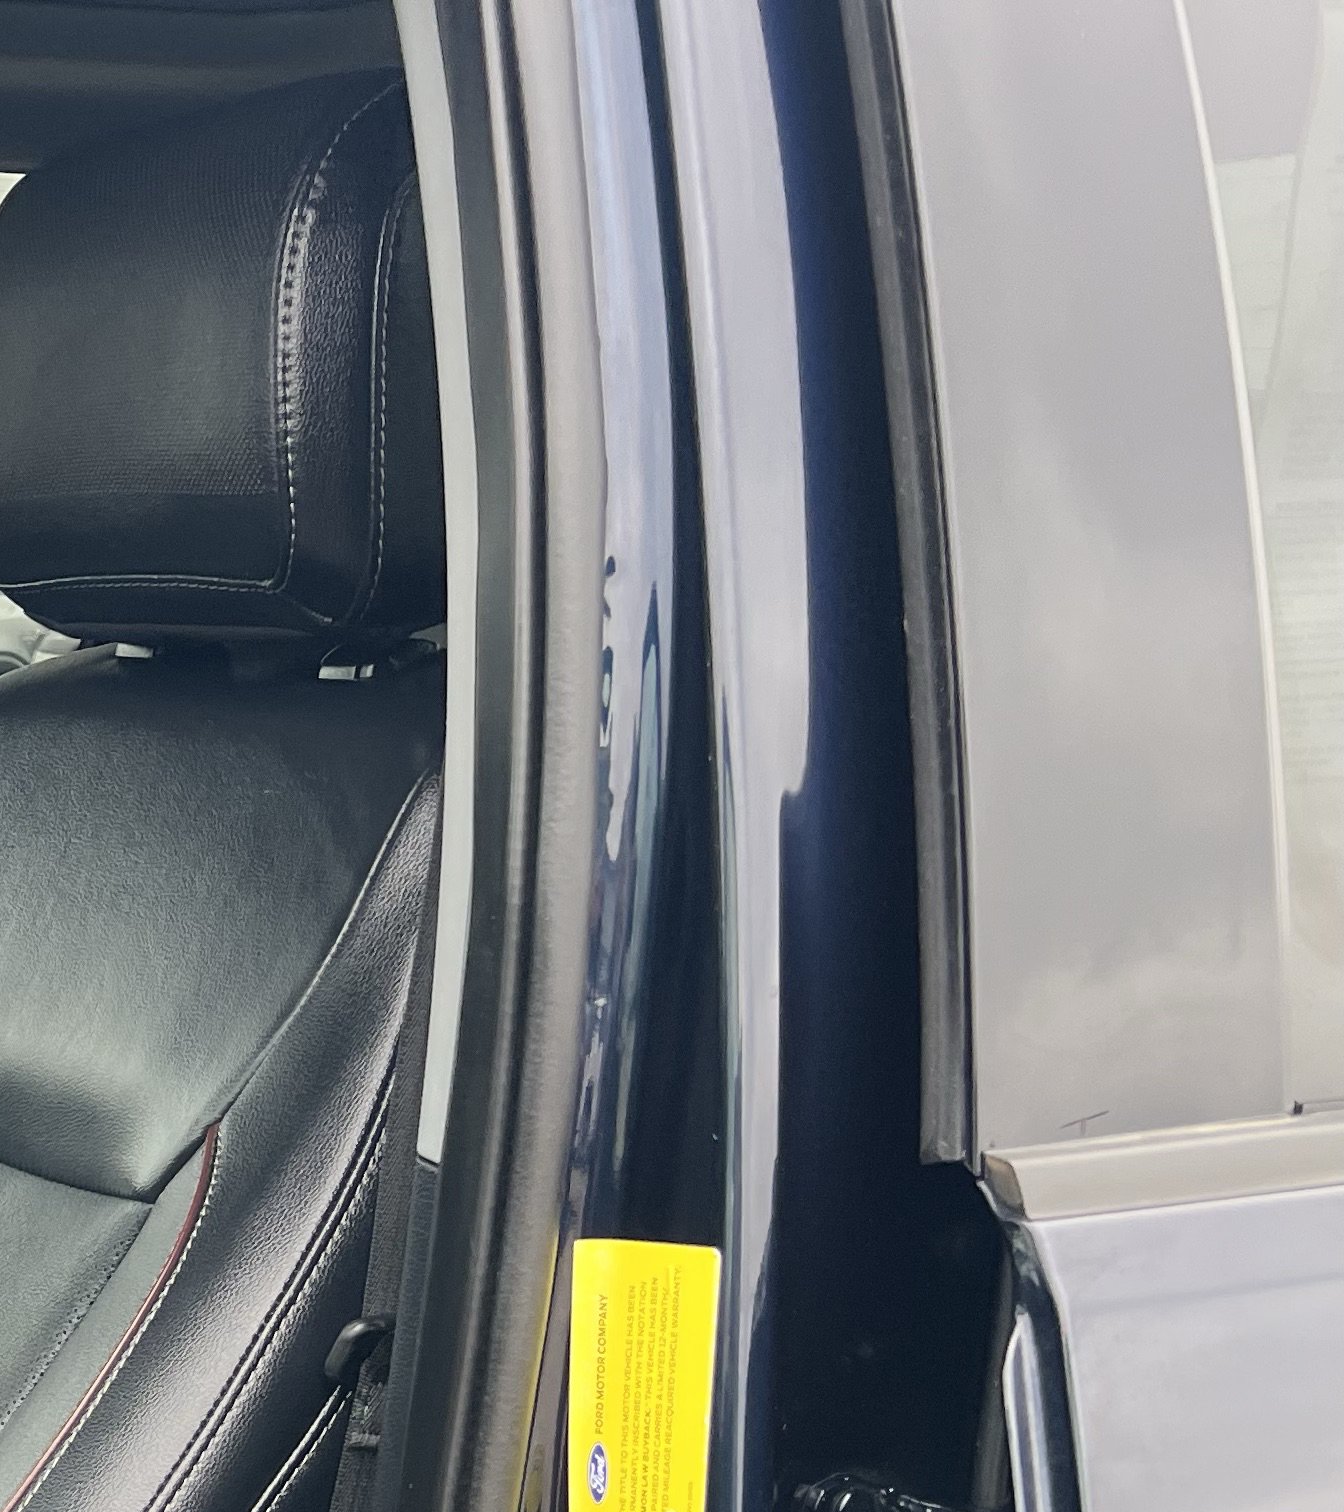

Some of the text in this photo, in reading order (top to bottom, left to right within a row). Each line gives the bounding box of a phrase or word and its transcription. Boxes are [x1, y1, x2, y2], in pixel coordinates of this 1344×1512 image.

[627, 1284, 636, 1313] BEEN
[650, 1276, 658, 1305] BEEN
[637, 1280, 647, 1336] NOTATION
[648, 1306, 656, 1329] HAS
[625, 1314, 634, 1337] HAS
[623, 1338, 633, 1381] VEHICLE
[636, 1338, 644, 1359] THE
[646, 1330, 655, 1375] VEHICLE
[668, 1330, 677, 1375] VEHICLE
[594, 1293, 608, 1435] FORD MOTOR COMPANY
[634, 1360, 642, 1389] WITH
[656, 1349, 665, 1392] LIMITED
[644, 1375, 653, 1401] THIS
[655, 1393, 663, 1401] A
[621, 1383, 630, 1423] MOTOR
[631, 1389, 641, 1446] INSCRIBED
[663, 1376, 676, 1445] REACQUIRED
[620, 1424, 629, 1449] THIS
[653, 1403, 663, 1448] CARRIES
[620, 1449, 628, 1464] TO
[652, 1448, 660, 1472] AND
[662, 1446, 671, 1492] MILEAGE
[589, 1452, 606, 1494] Ford
[619, 1466, 627, 1495] TITLE
[641, 1463, 649, 1488] LAW
